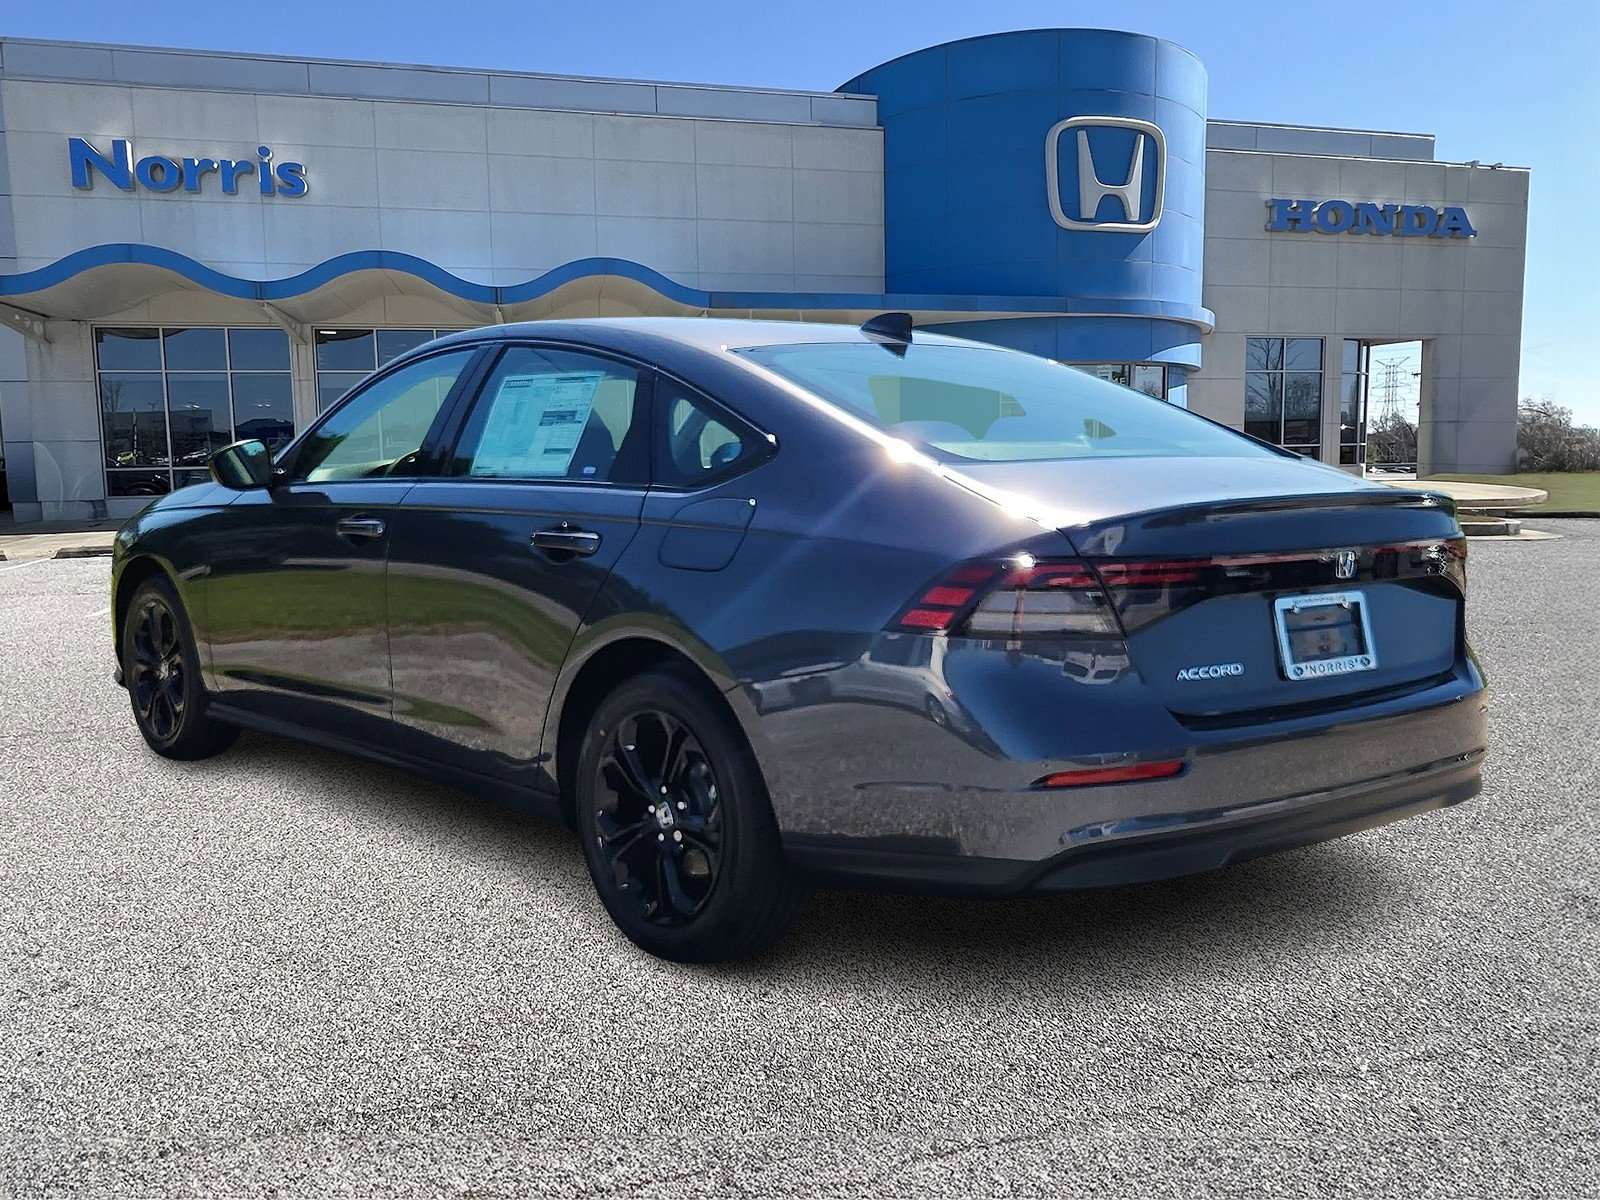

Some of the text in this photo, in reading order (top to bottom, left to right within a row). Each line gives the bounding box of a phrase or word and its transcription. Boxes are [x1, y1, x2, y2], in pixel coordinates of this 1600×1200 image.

[68, 137, 309, 197] Norris
[1265, 198, 1478, 239] HONDA
[1176, 662, 1245, 681] ACCORD
